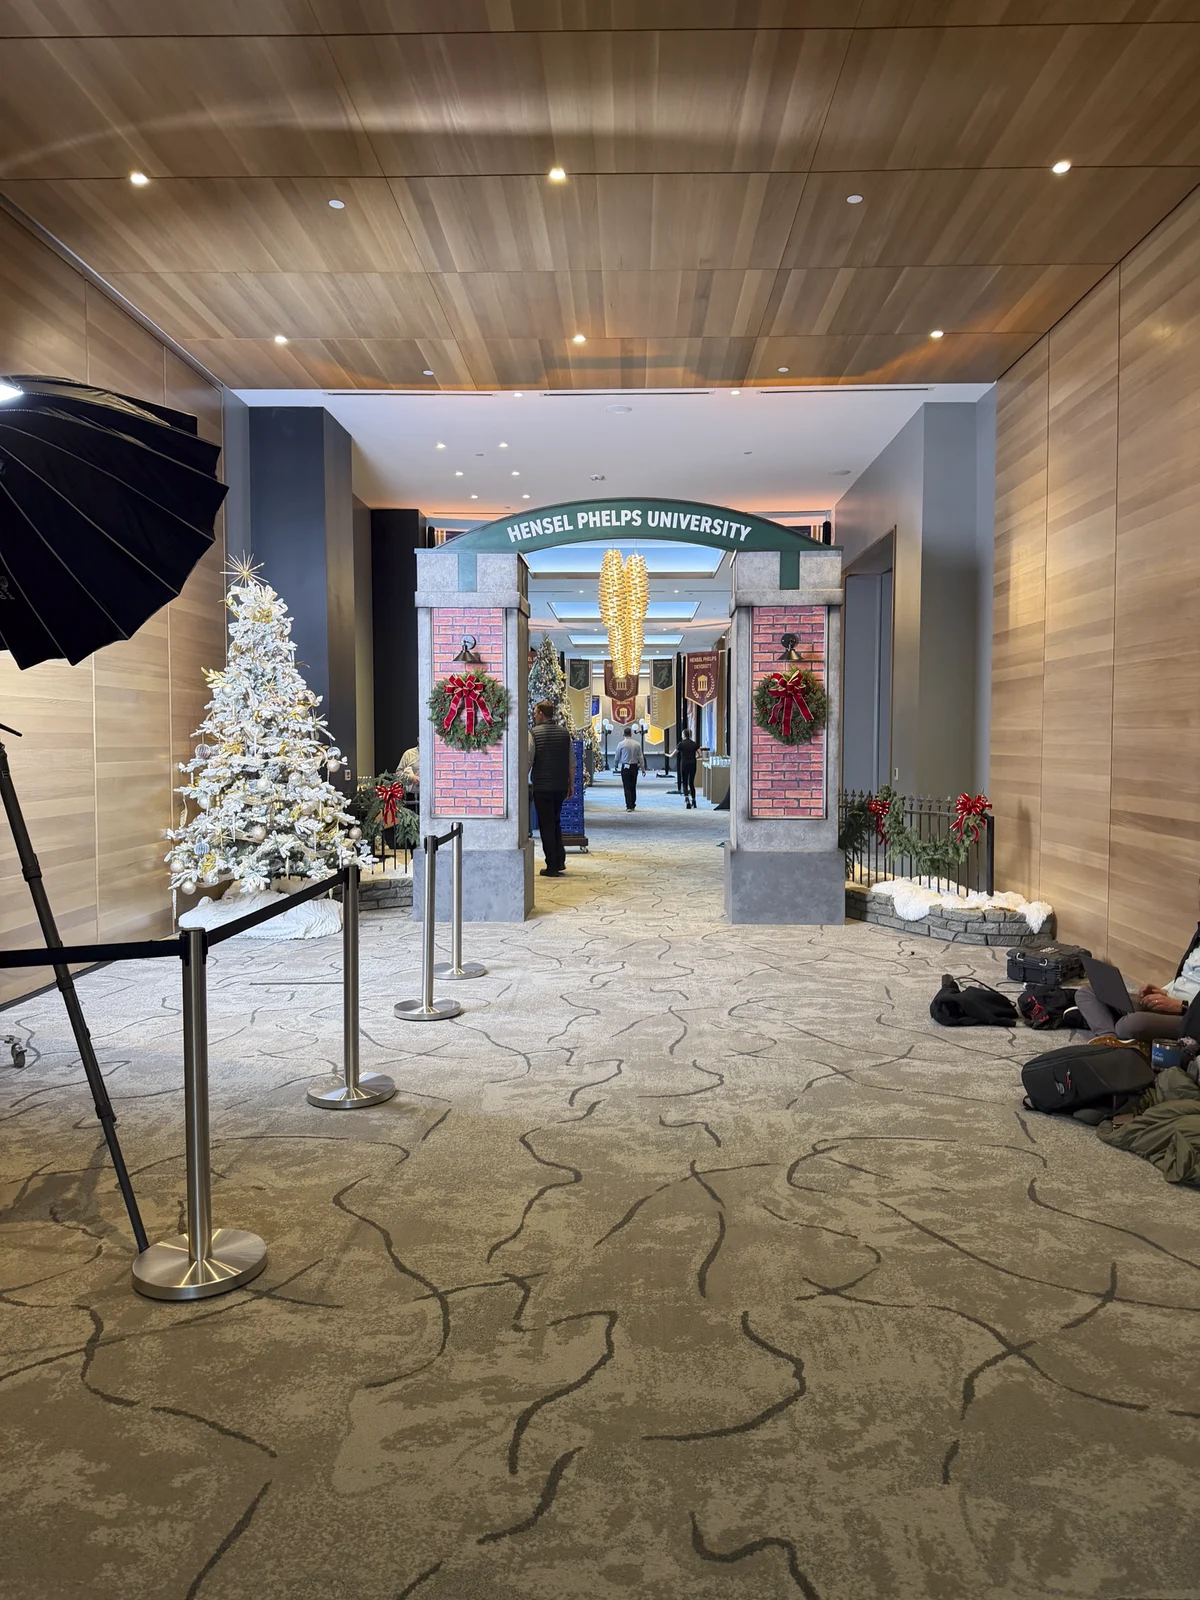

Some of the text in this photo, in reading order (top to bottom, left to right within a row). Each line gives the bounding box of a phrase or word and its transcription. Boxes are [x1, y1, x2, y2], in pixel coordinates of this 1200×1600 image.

[507, 509, 752, 543] HENSEL PHELPS UNIVERSITY
